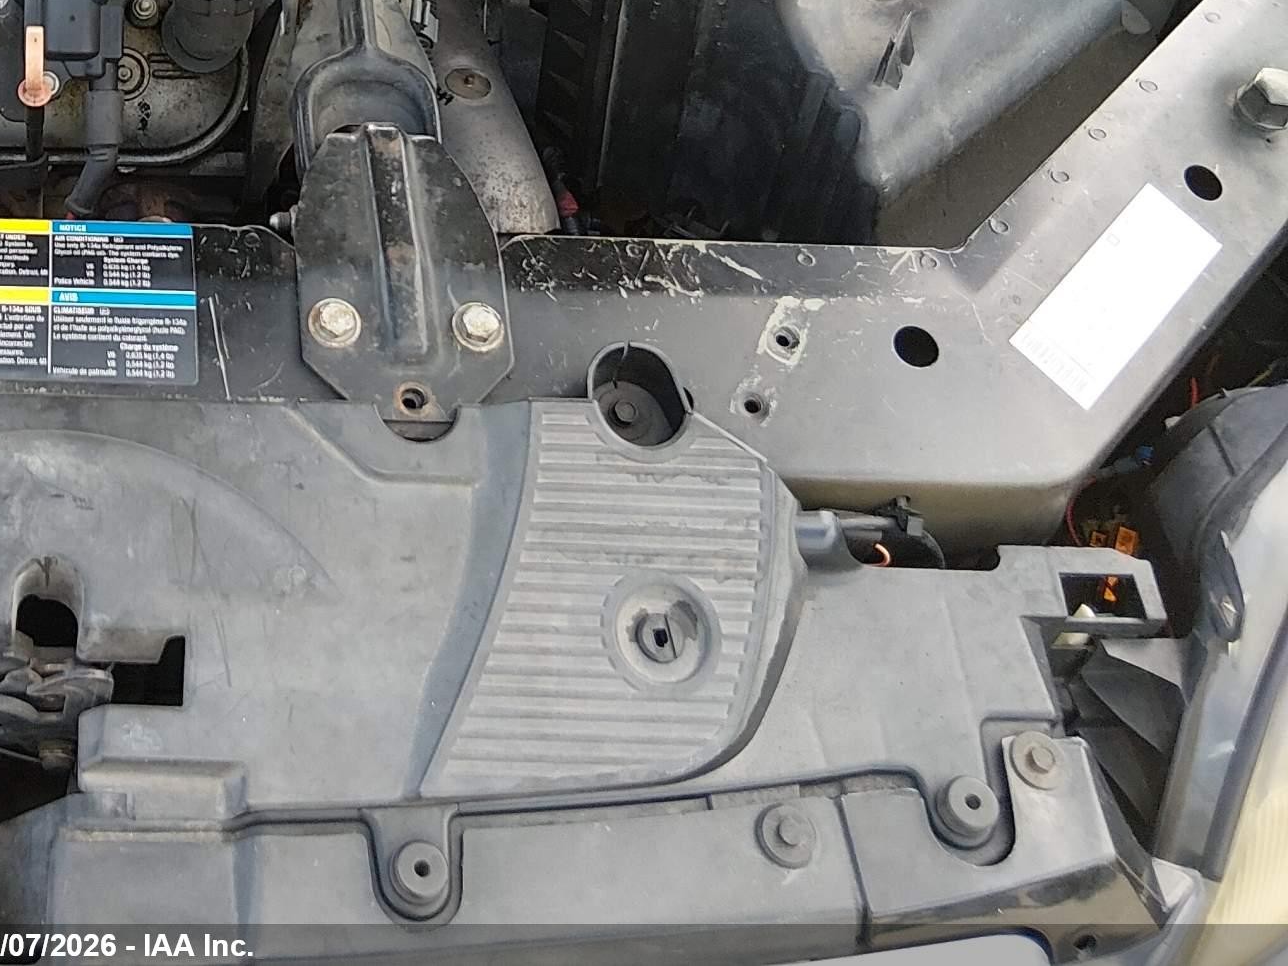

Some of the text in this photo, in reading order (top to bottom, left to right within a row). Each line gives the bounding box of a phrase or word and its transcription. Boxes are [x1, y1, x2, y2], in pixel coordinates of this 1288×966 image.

[120, 271, 129, 279] kg
[120, 279, 129, 287] kg
[59, 292, 79, 302] AVIS
[53, 306, 95, 314] CLIMATISEUR
[75, 316, 106, 324] seulement
[120, 342, 141, 351] Charge
[143, 352, 152, 360] kg
[143, 360, 152, 369] kg
[143, 369, 152, 378] kg
